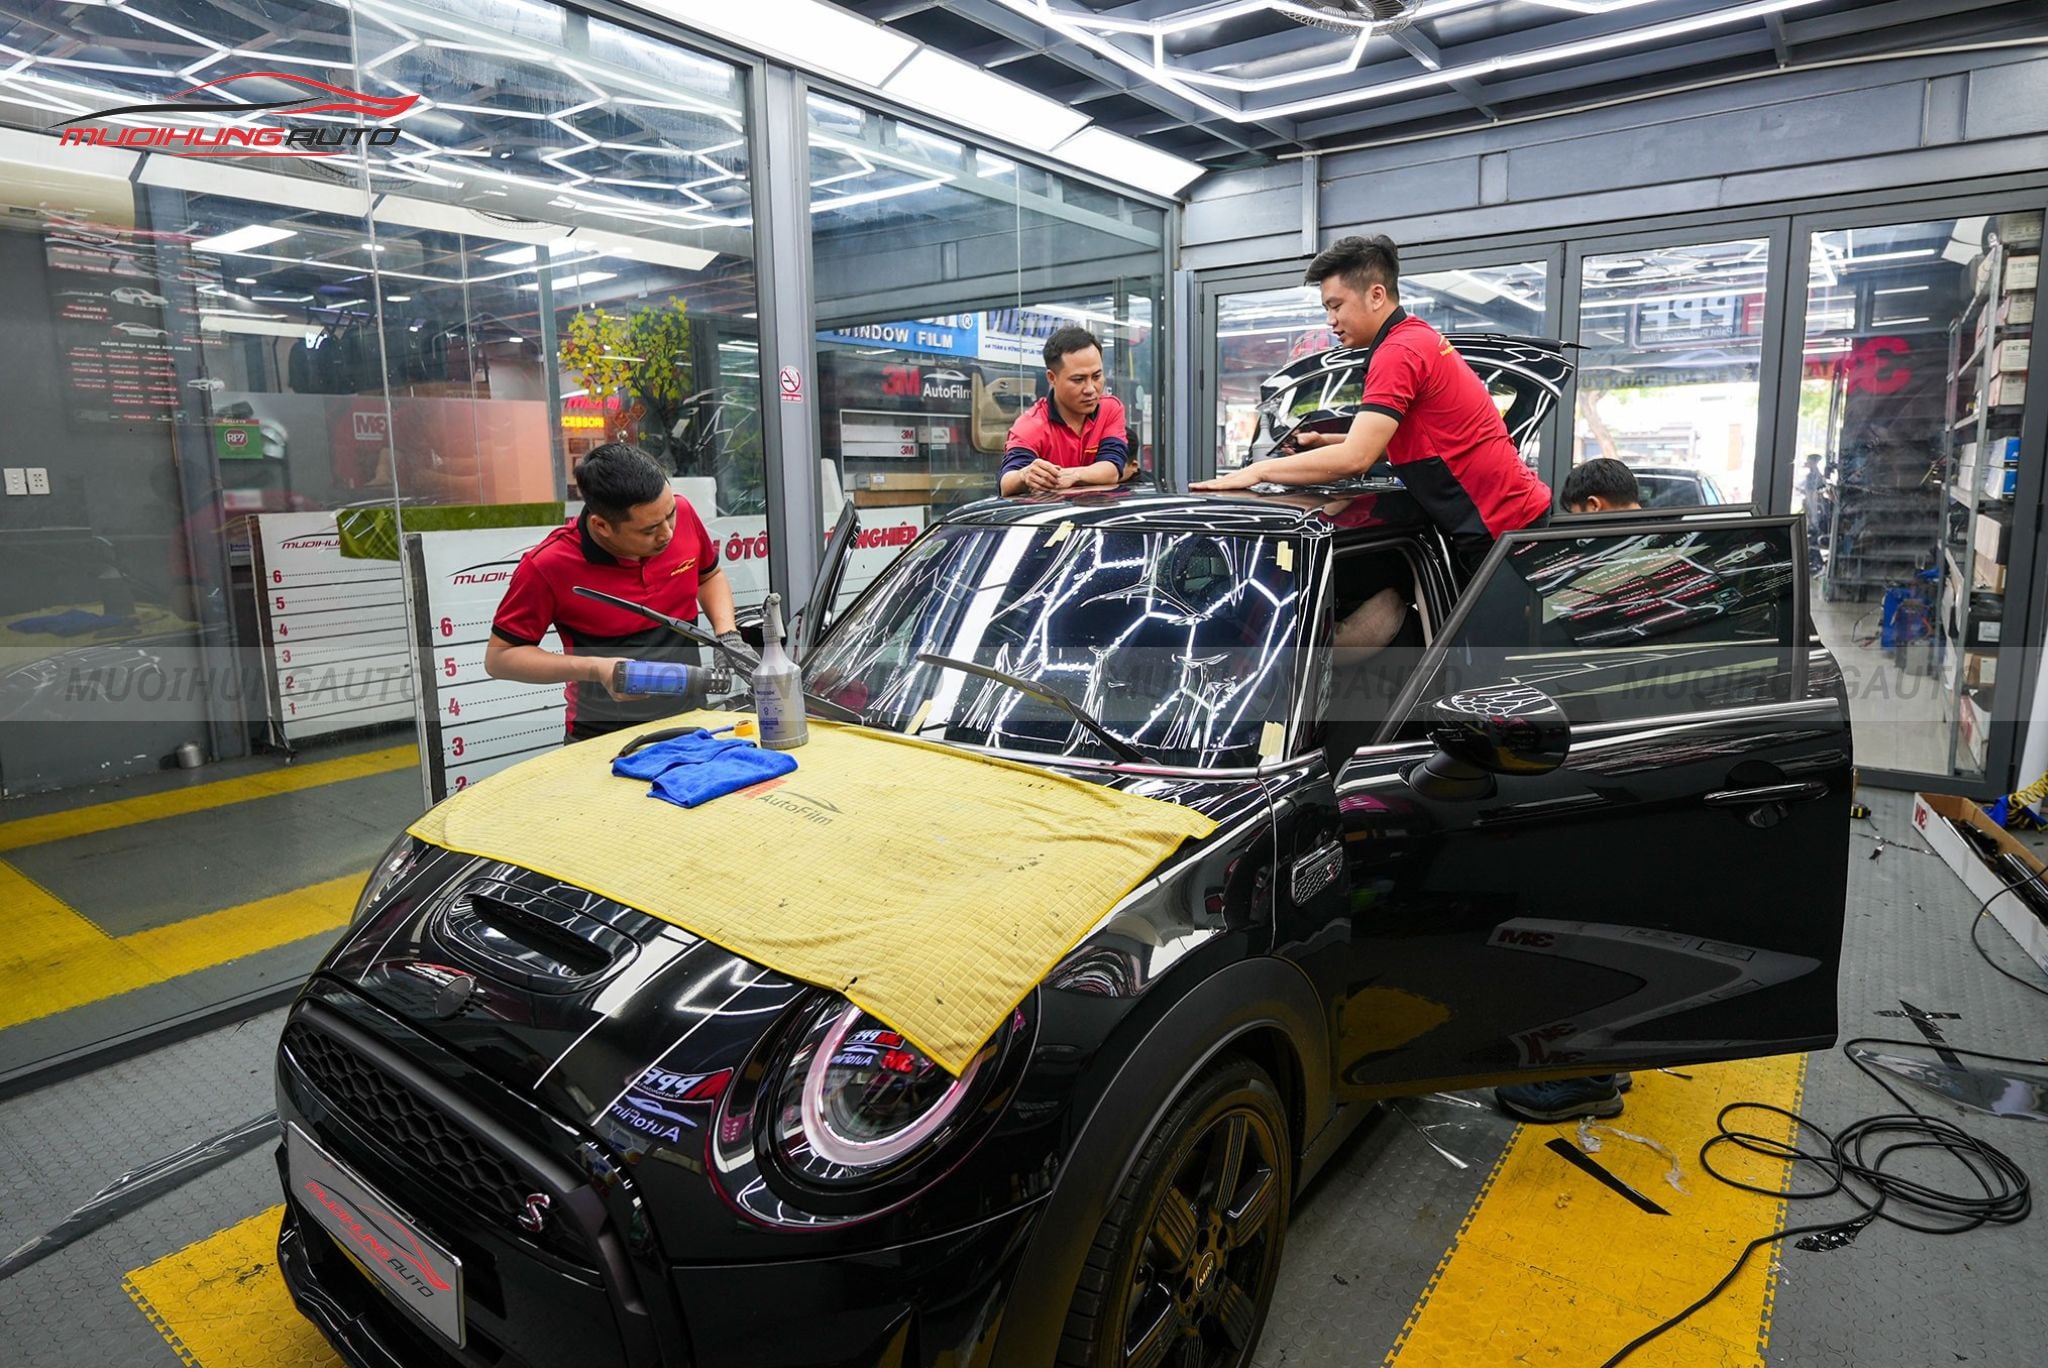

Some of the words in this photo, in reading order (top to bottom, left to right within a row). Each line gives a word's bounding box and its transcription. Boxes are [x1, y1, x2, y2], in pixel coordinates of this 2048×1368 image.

[917, 332, 953, 348] FILM
[881, 365, 922, 396] 3M
[227, 433, 245, 442] RP7
[901, 430, 914, 440] 3M
[901, 445, 914, 455] 3M
[273, 570, 282, 584] 6
[454, 572, 513, 585] MUOIH
[276, 597, 285, 610] 5
[279, 623, 288, 636] 4
[440, 617, 453, 637] 6
[282, 650, 291, 663] 3
[444, 657, 457, 677] 5
[285, 676, 295, 689] 2
[289, 702, 296, 715] 1
[448, 698, 460, 716] 4
[452, 737, 464, 756] 3
[455, 775, 467, 792] 2
[756, 794, 833, 826] AutoFilm
